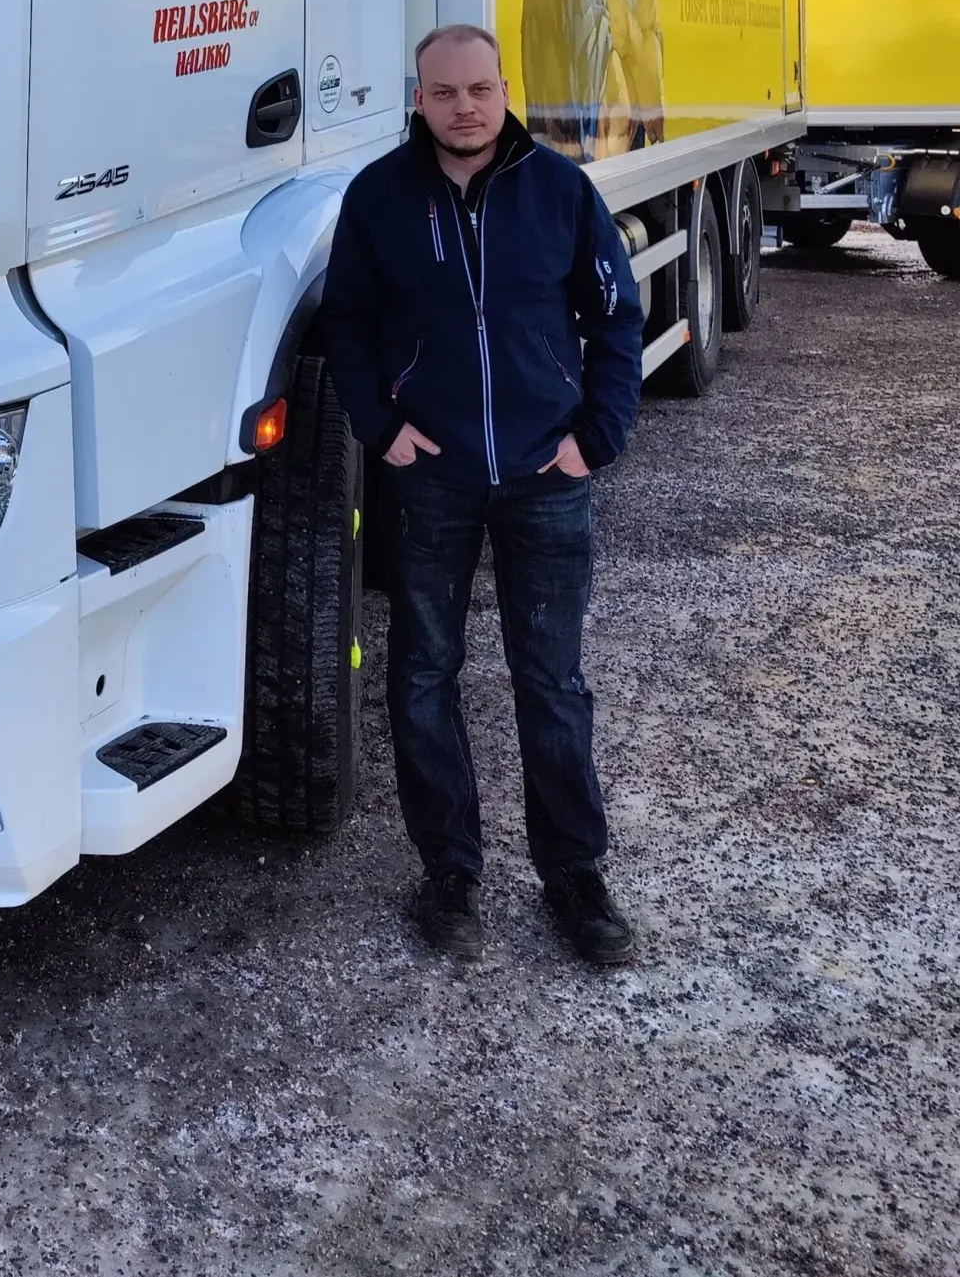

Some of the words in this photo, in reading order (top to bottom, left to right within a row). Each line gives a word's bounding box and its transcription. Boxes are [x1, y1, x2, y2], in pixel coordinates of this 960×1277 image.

[249, 10, 260, 28] OY
[175, 42, 231, 77] HALIKKO
[55, 164, 130, 201] 2545
